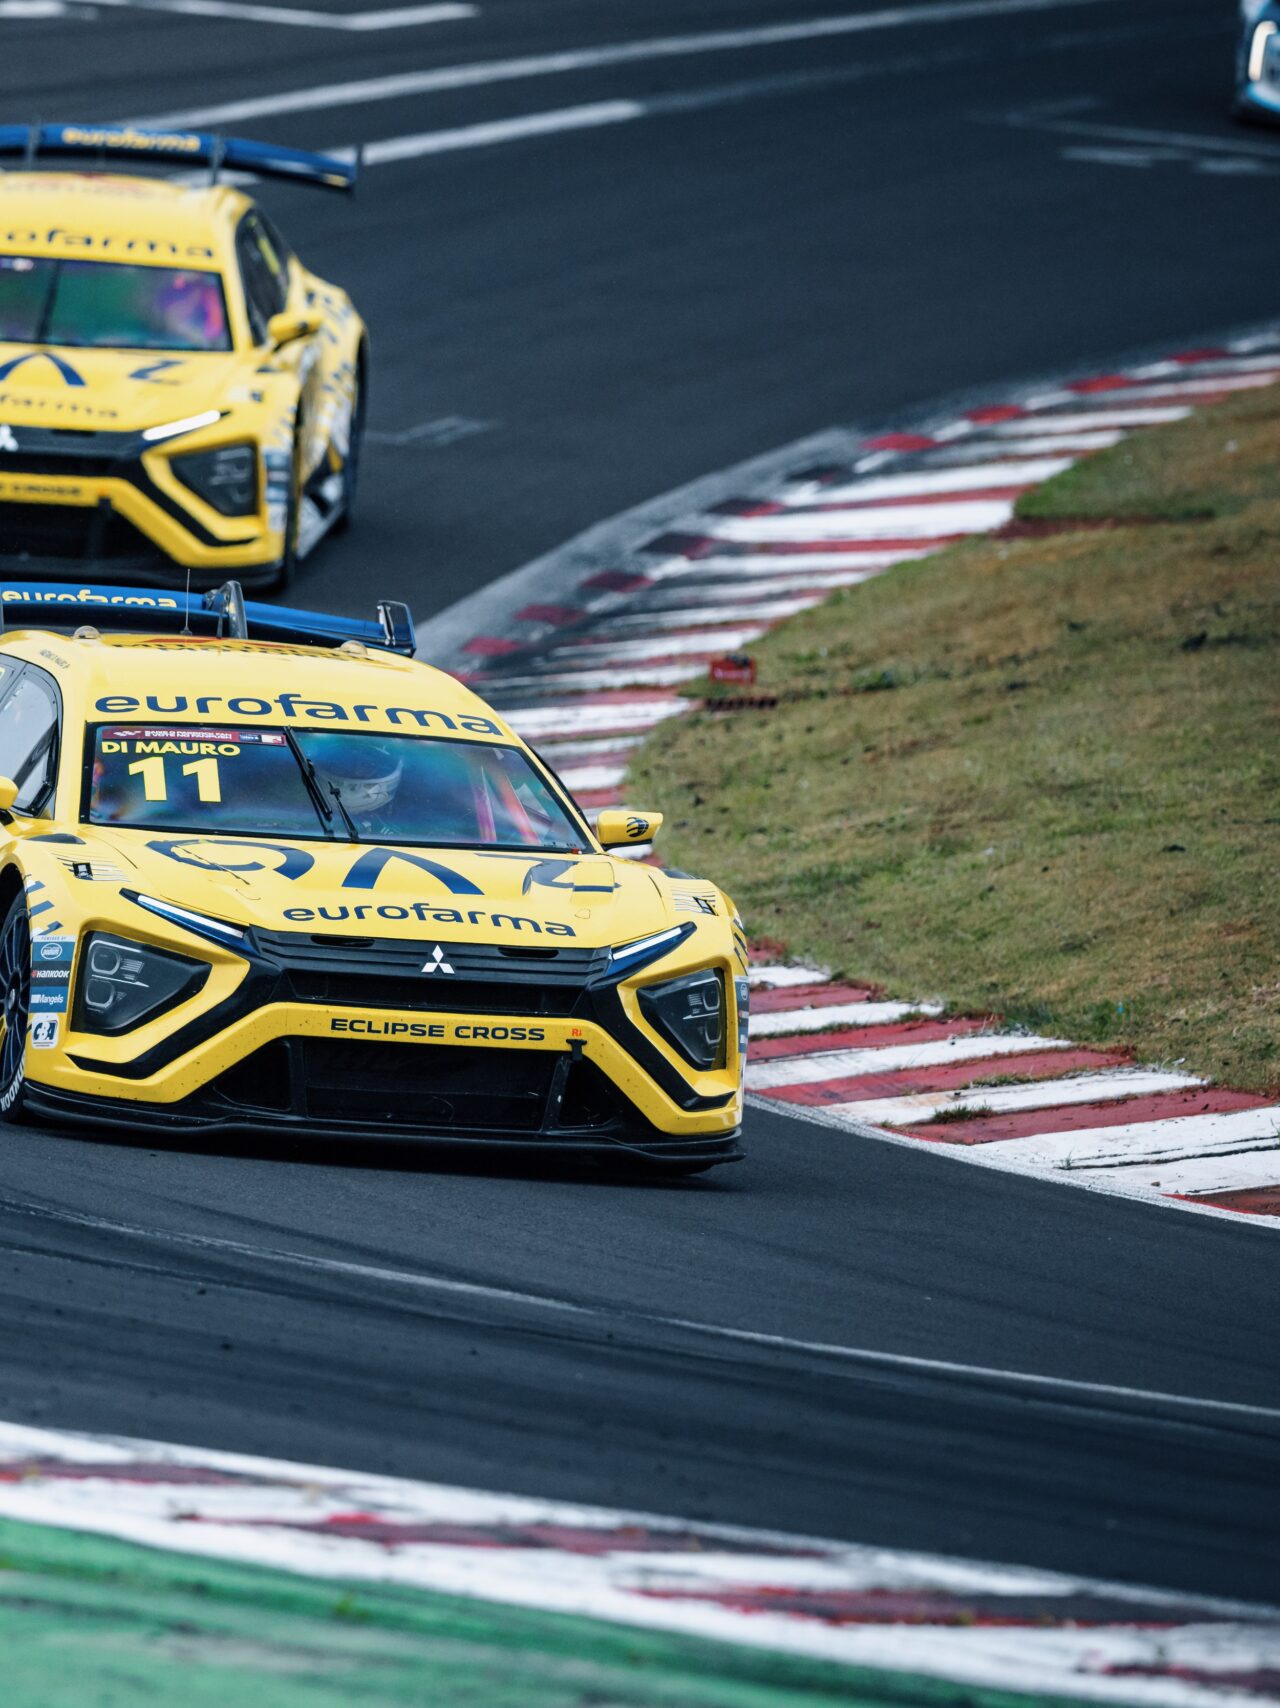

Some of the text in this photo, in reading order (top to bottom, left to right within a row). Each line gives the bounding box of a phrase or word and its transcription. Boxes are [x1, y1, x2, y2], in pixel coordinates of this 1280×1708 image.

[94, 693, 505, 737] eurofarma
[102, 741, 241, 757] DI MAURO
[128, 756, 222, 802] 11
[282, 902, 577, 938] eurofarma
[330, 1017, 546, 1042] ECLIPSE CROSS
